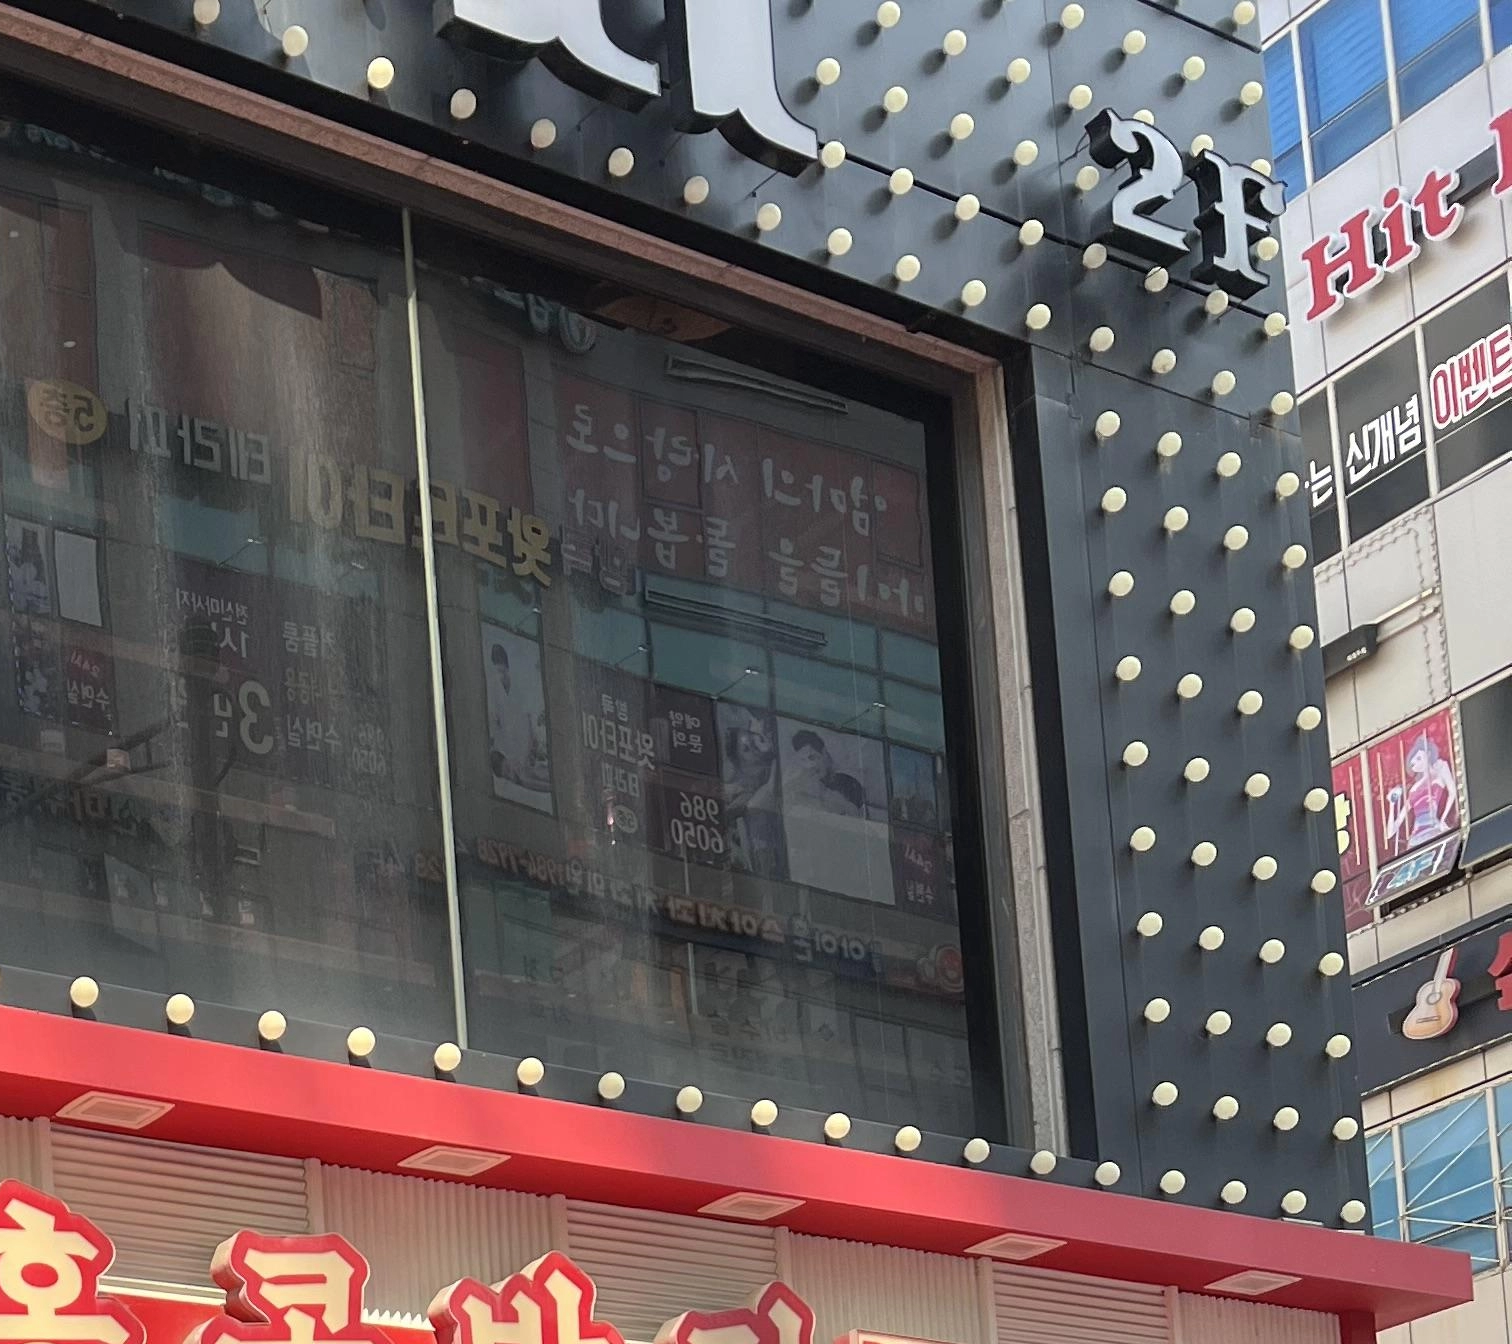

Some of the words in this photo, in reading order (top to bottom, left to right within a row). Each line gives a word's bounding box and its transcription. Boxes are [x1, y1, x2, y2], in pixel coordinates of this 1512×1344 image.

[1096, 108, 1288, 297] 2F
[1300, 165, 1465, 321] Hit
[1303, 458, 1335, 510] 는
[1345, 392, 1422, 486] 신개념
